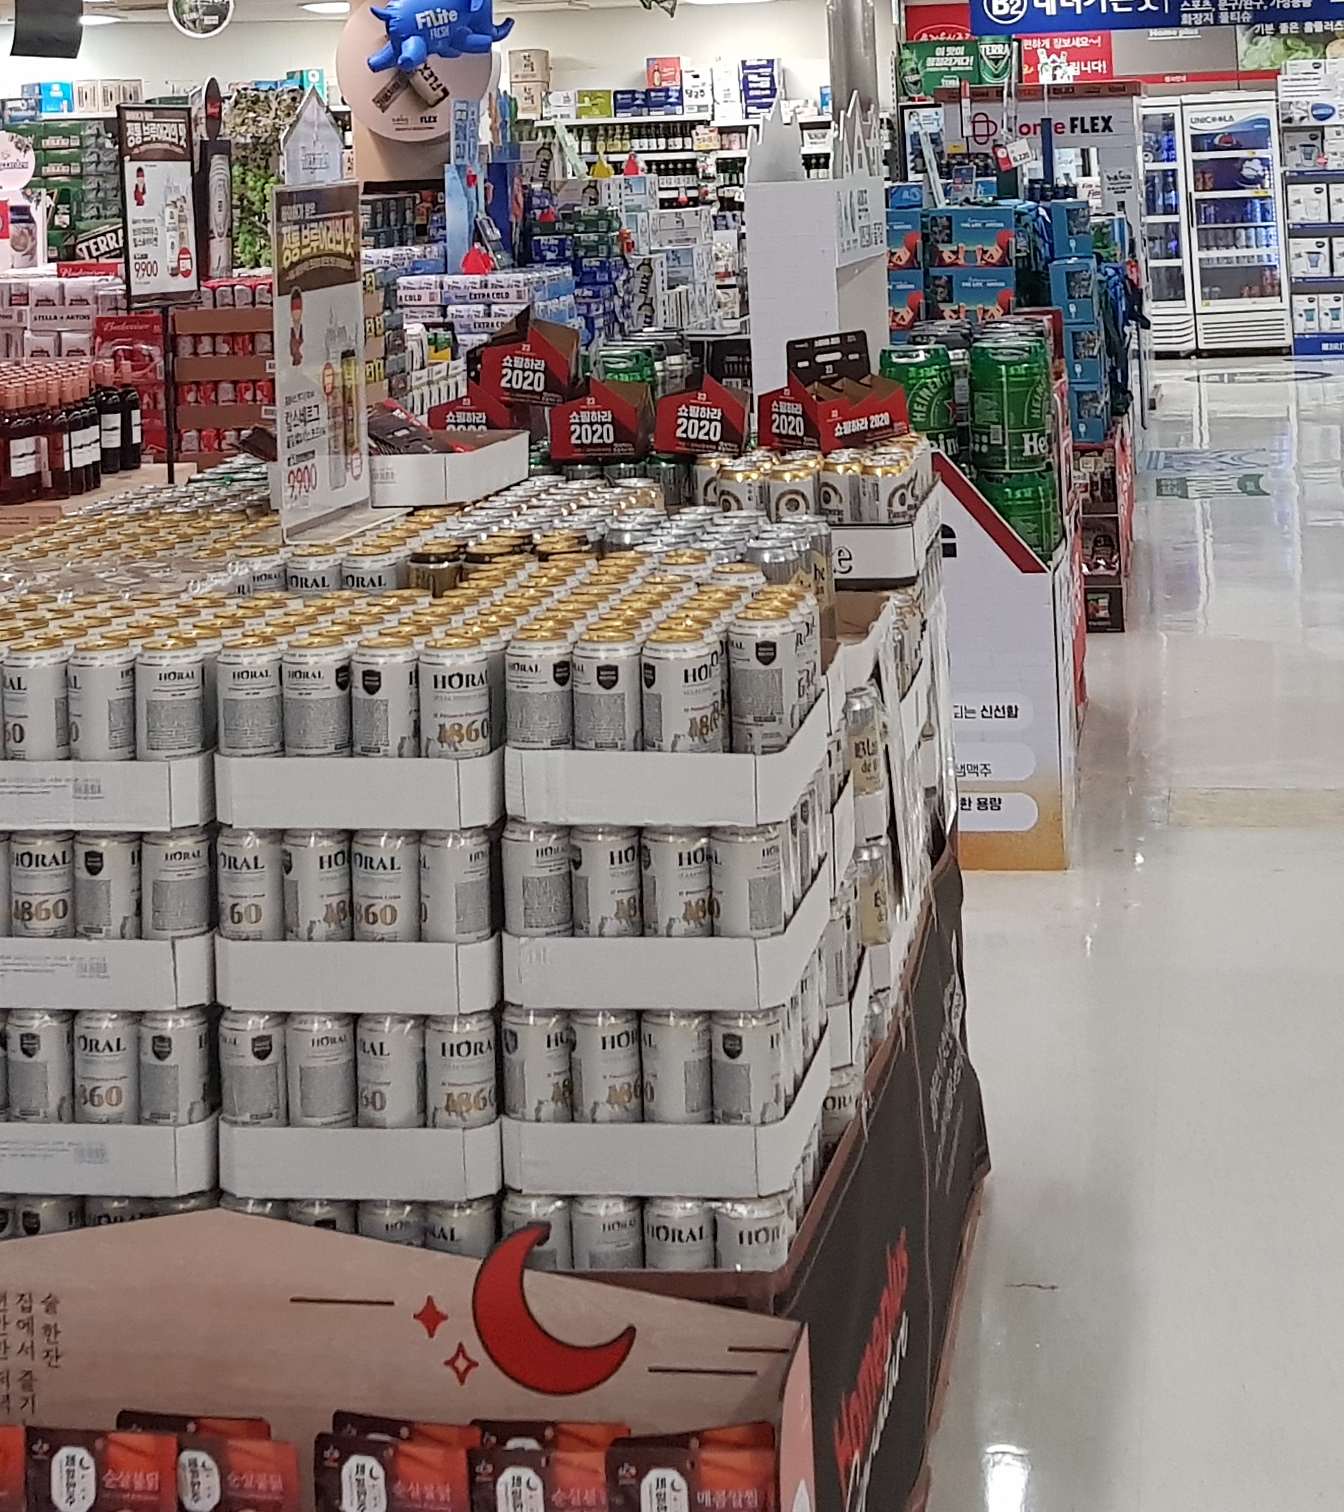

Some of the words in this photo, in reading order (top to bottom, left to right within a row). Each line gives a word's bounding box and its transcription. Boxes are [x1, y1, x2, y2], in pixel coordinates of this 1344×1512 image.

[1179, 0, 1216, 13] 스포츠,
[1180, 12, 1215, 26] 화장지
[1069, 115, 1114, 134] FLEX
[500, 368, 546, 392] 2020
[772, 414, 805, 437] 2020
[869, 412, 891, 428] 2020
[569, 423, 614, 445] 2020
[676, 418, 722, 442] 2020
[979, 703, 1020, 721] 신선함
[976, 797, 1003, 813] 용량
[16, 1291, 35, 1362] 집에서
